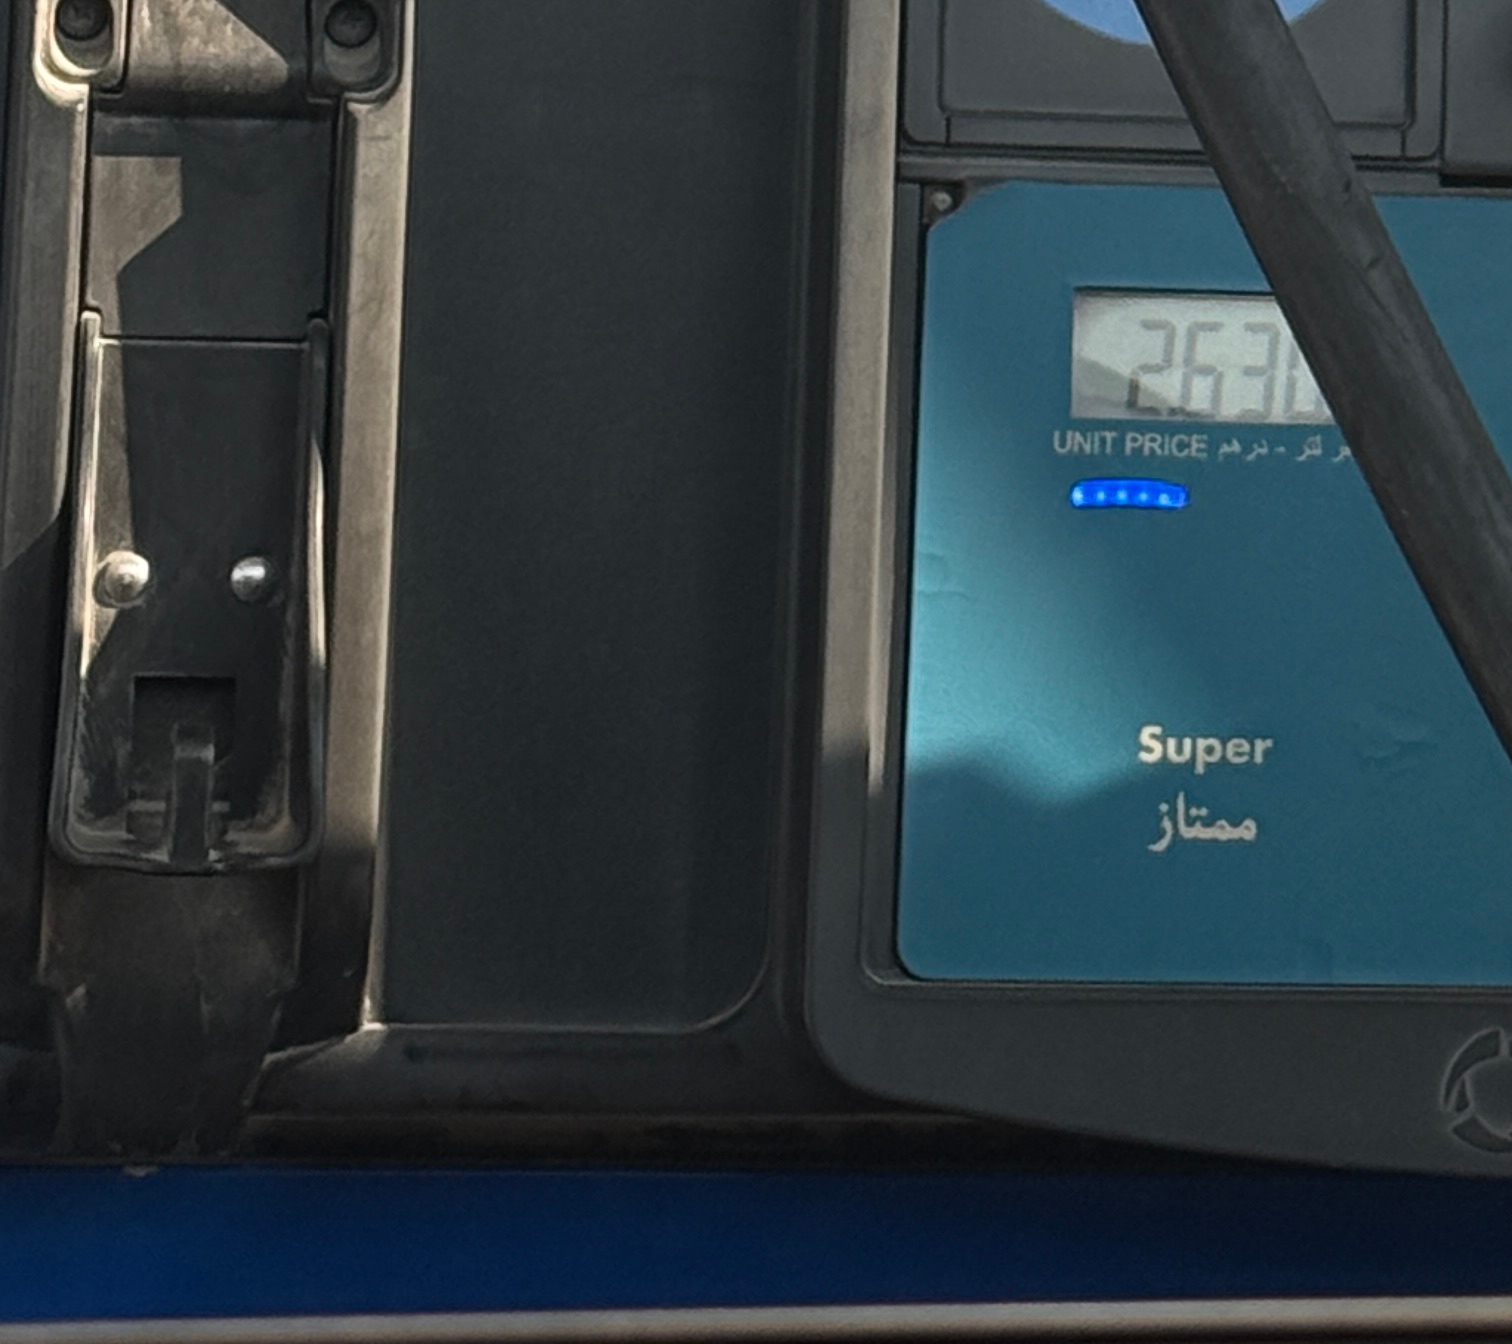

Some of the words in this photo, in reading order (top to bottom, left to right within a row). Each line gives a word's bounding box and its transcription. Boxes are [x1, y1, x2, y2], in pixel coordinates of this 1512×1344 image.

[1053, 430, 1118, 456] UNIT
[1124, 433, 1208, 459] PRICE
[1137, 724, 1275, 775] Super
[1147, 791, 1258, 852] ممتاز
